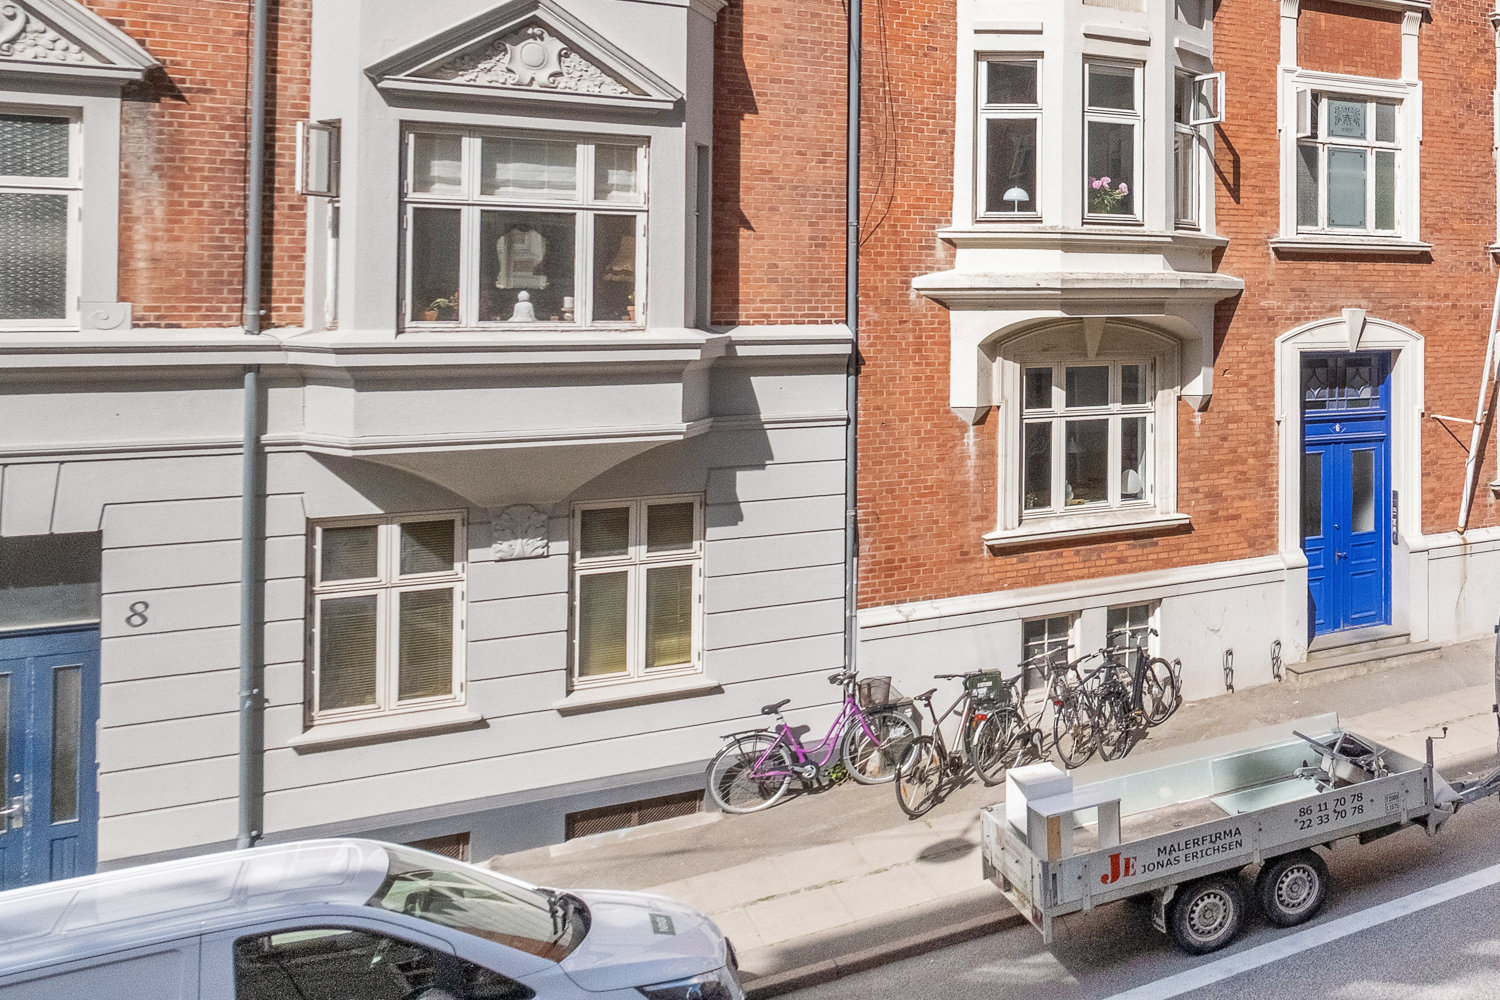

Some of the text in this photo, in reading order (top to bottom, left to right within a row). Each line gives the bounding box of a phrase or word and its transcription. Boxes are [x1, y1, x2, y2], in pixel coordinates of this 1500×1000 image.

[125, 601, 149, 628] 8
[1299, 792, 1363, 818] 86 11 70 78
[1299, 805, 1364, 830] 22 33 70 78
[1157, 827, 1242, 857] MALERFIRMA
[1101, 852, 1137, 884] JE
[1141, 839, 1243, 875] JONAS ERICHSEN
